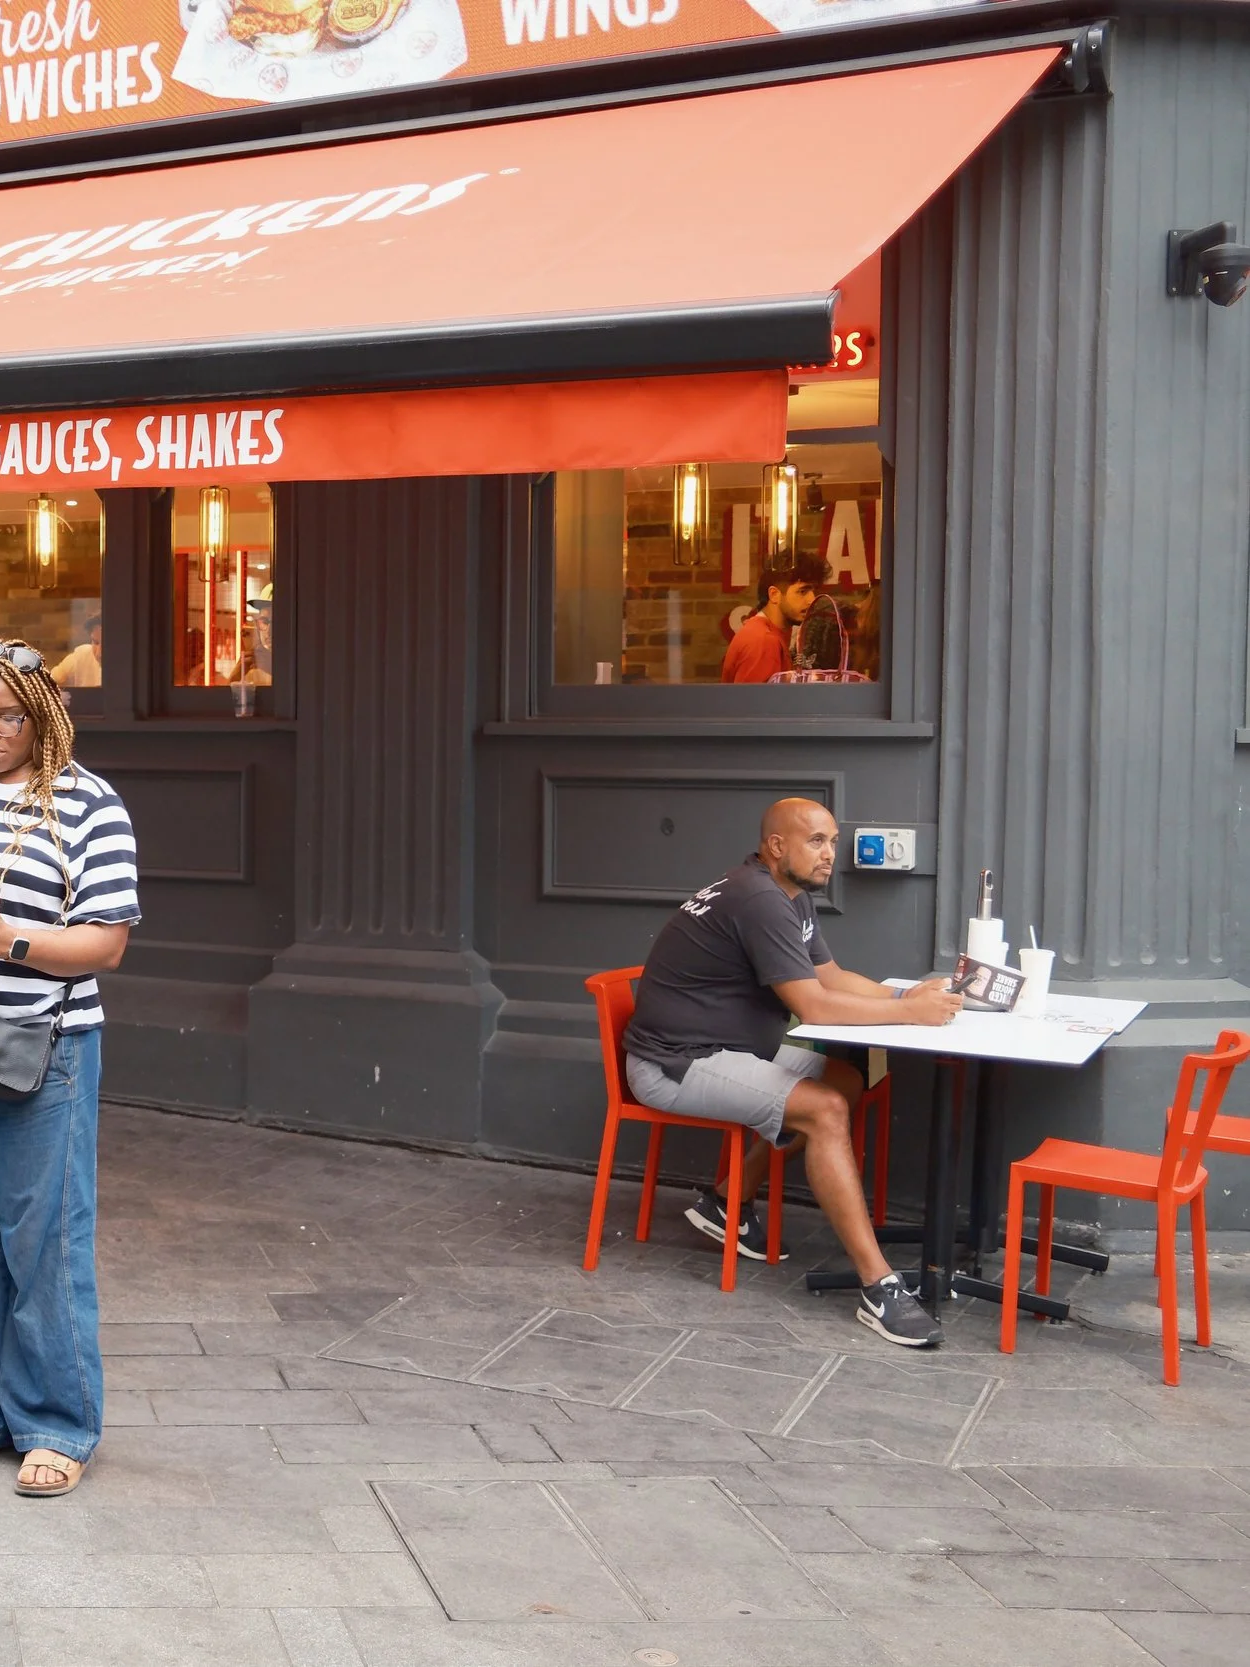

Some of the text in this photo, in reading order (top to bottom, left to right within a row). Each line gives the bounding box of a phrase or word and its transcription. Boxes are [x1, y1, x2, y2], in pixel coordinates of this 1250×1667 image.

[132, 408, 284, 471] SHAKES
[995, 973, 1019, 988] SHAKE
[993, 982, 1014, 995] MOCHA
